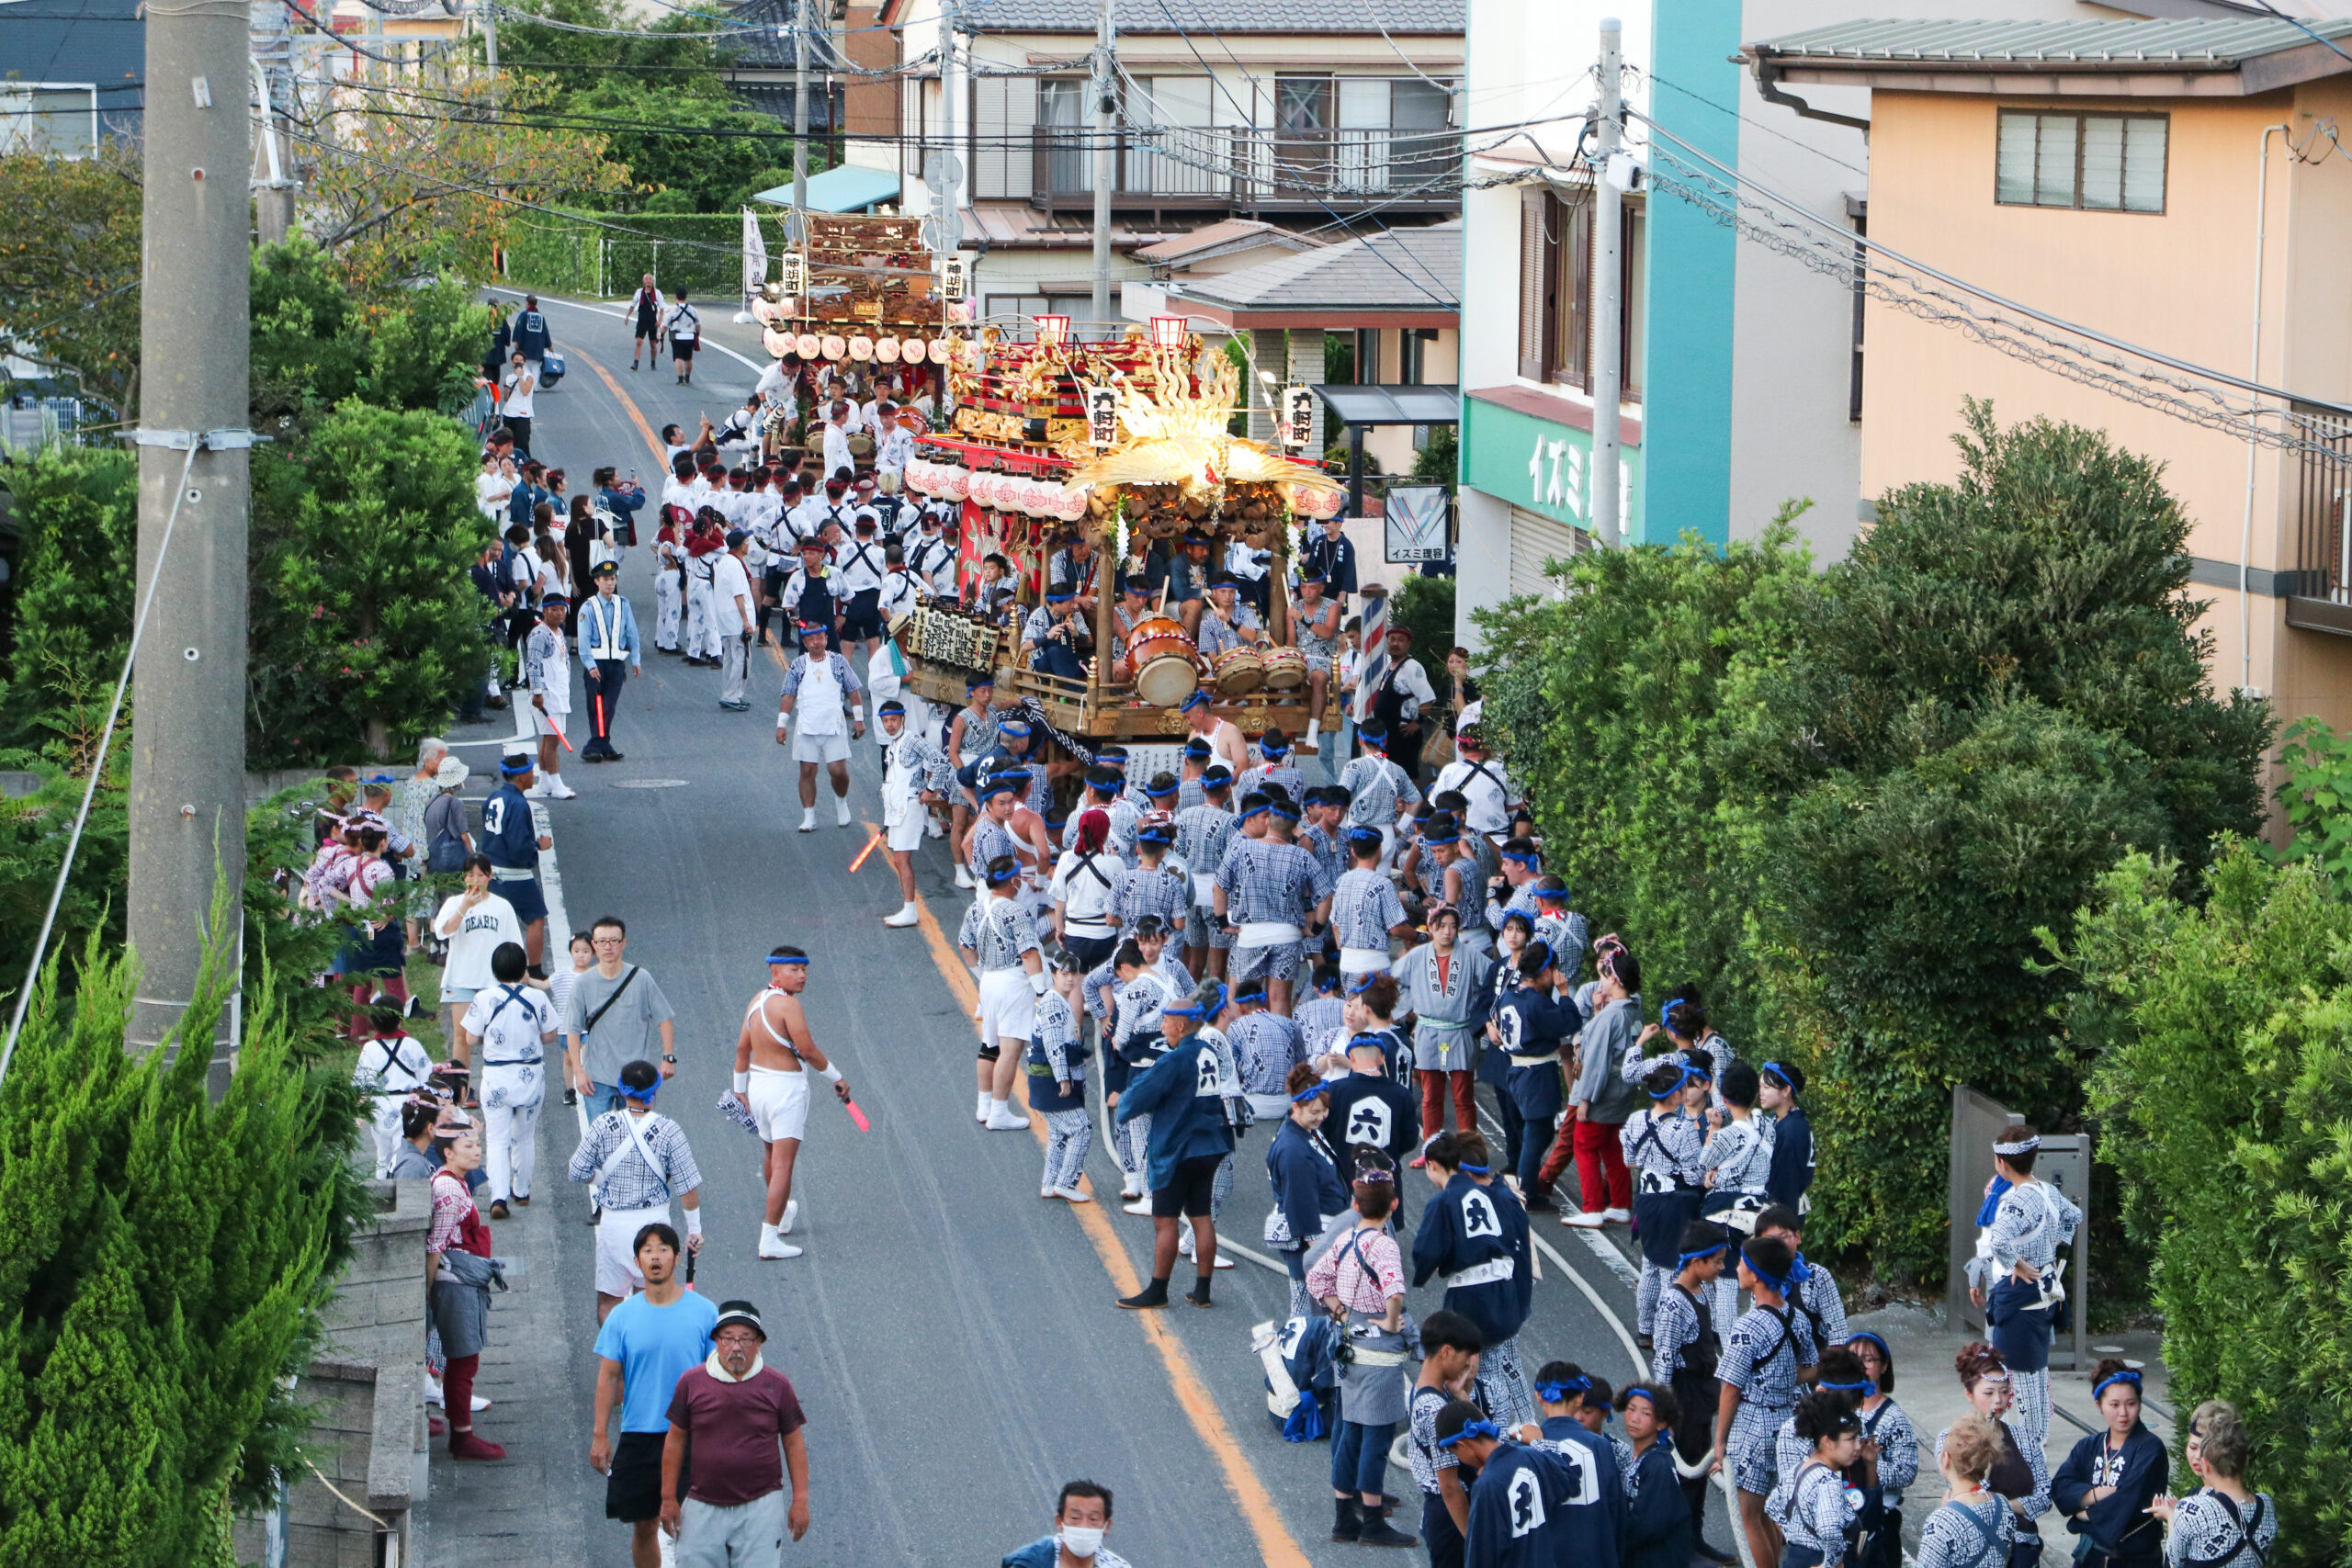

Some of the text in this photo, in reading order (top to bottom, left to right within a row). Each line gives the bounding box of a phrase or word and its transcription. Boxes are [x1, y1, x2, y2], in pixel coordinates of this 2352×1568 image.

[784, 257, 800, 291] 神明町
[946, 263, 962, 297] 神明町
[1093, 392, 1115, 443] 六軒町
[1292, 392, 1313, 443] 六軒町
[1200, 1059, 1216, 1089] 六
[1350, 1108, 1383, 1141] 六
[1465, 1198, 1493, 1232] 六
